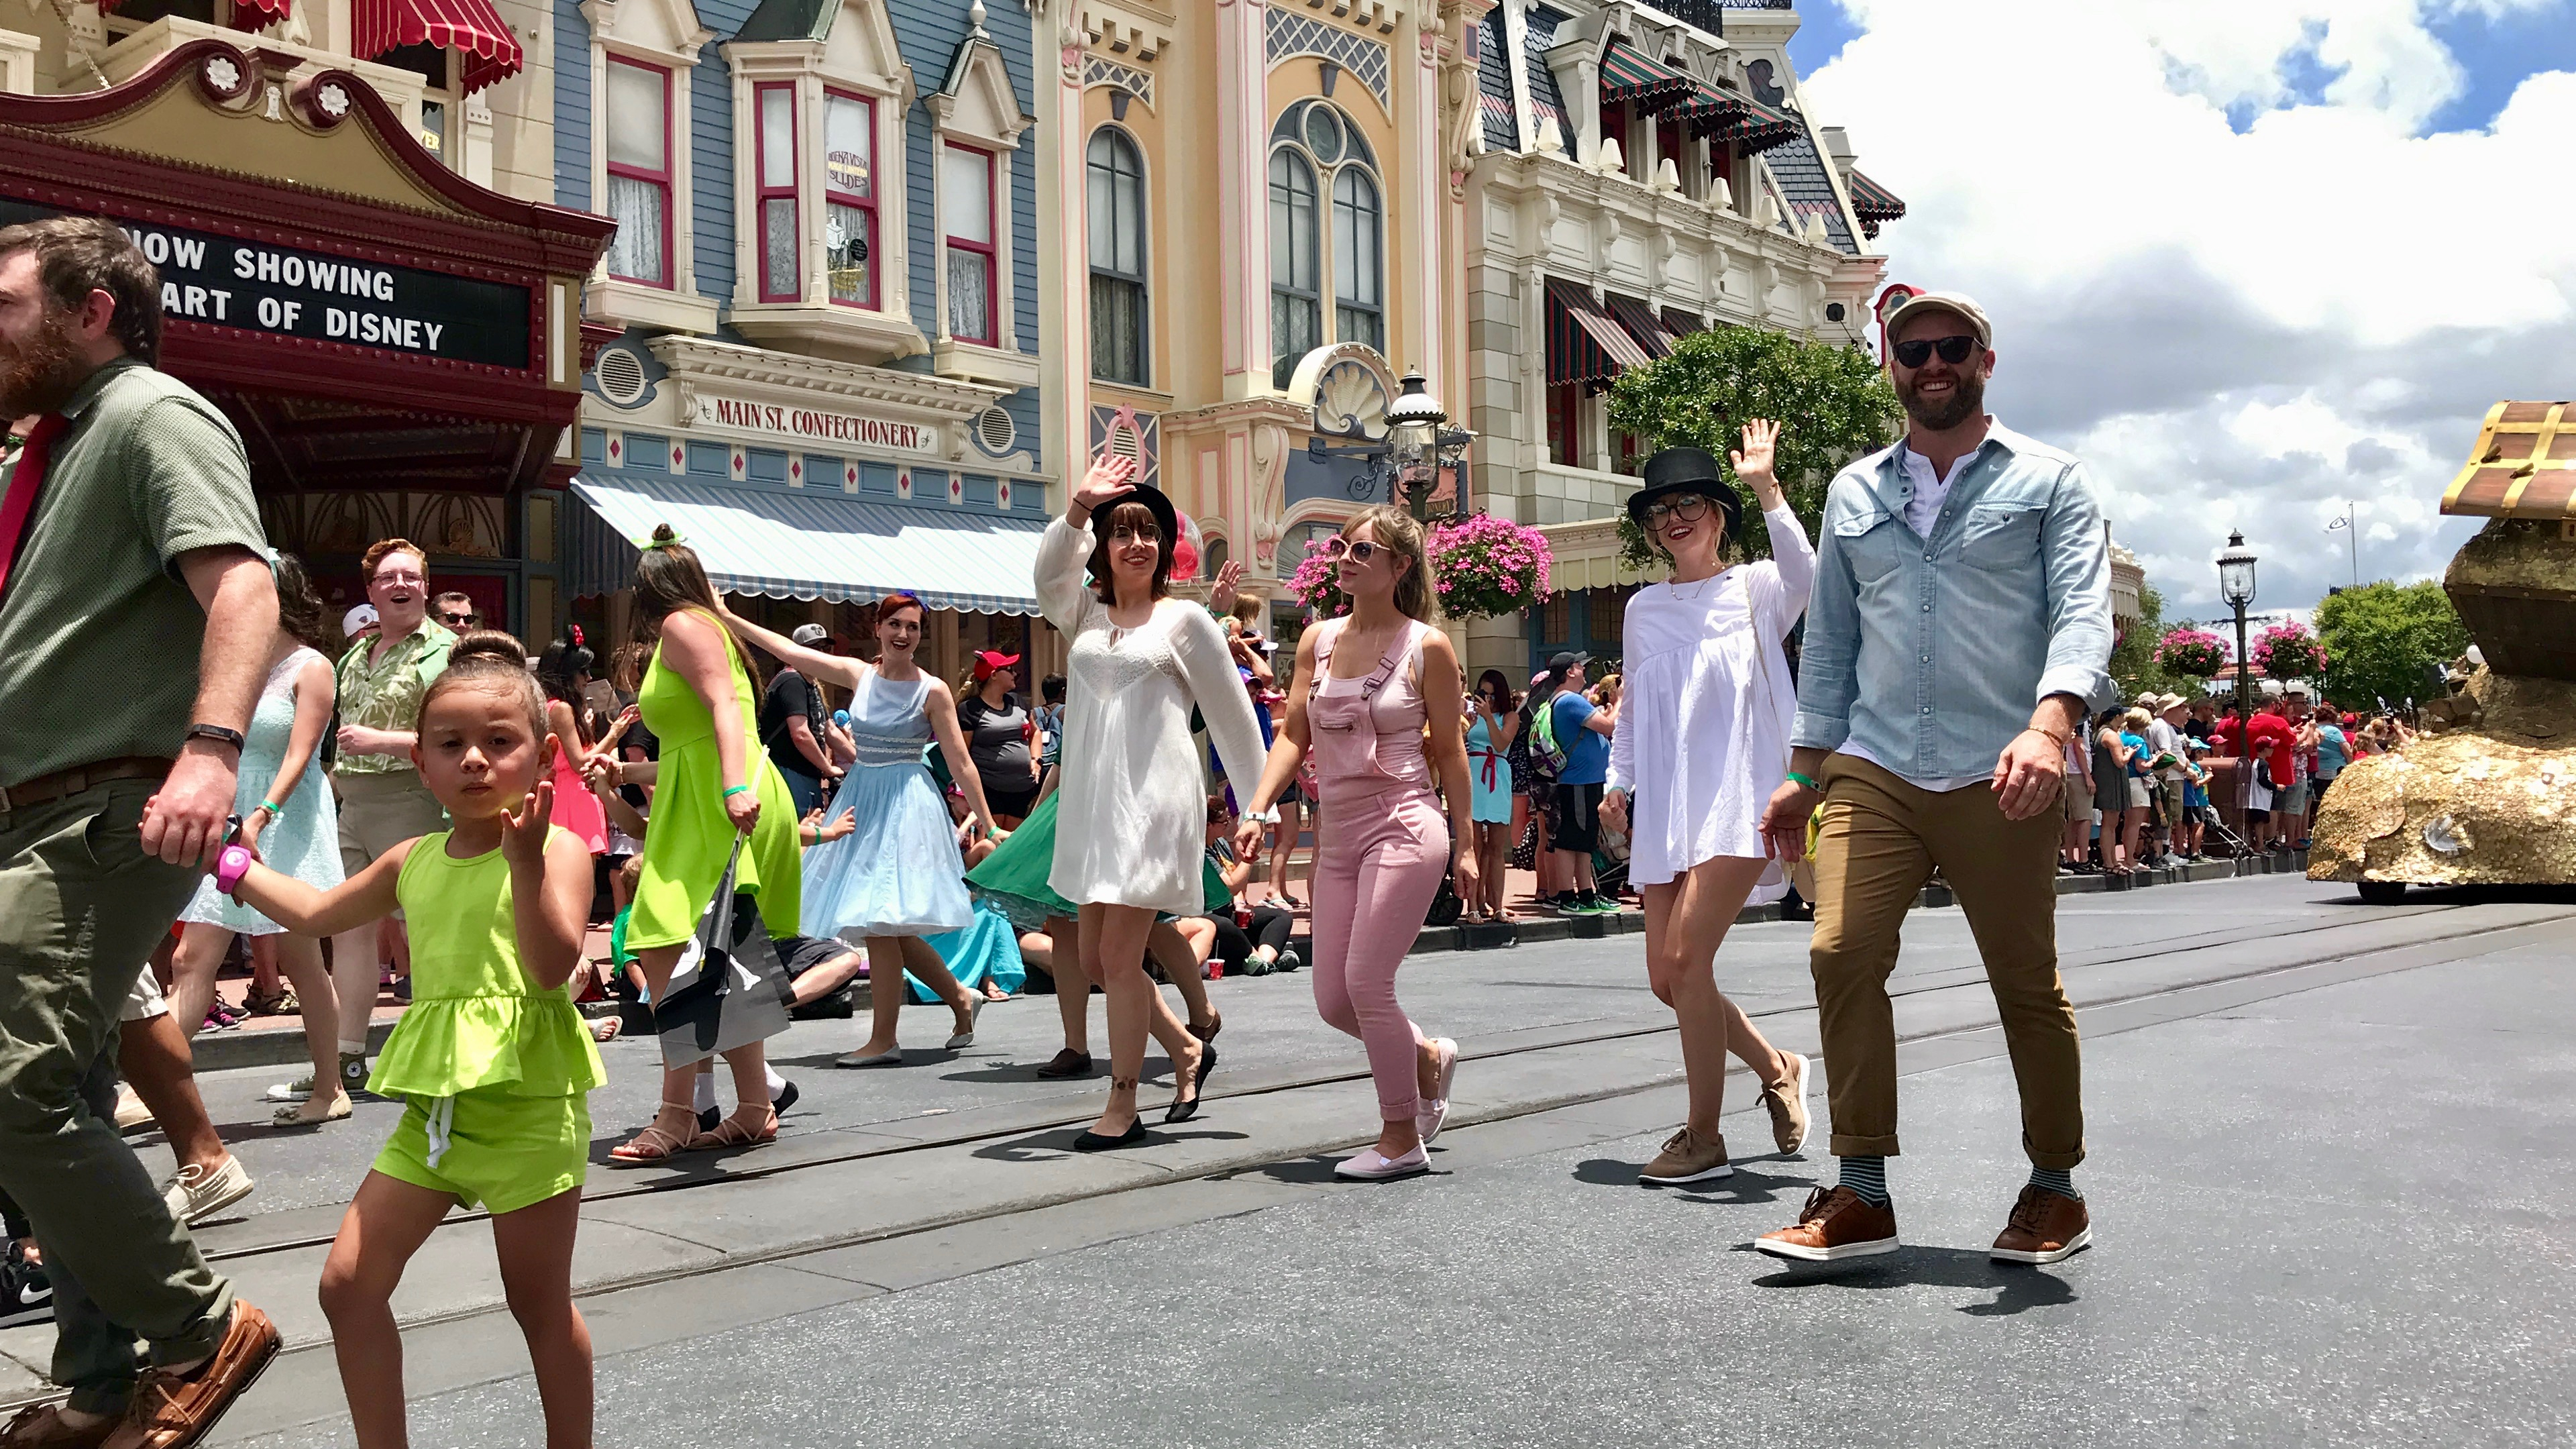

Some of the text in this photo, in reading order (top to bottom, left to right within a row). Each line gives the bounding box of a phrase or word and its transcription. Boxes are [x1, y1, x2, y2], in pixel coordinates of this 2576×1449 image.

[828, 151, 867, 169] BUENA VISTA
[829, 170, 867, 189] SLIDES
[233, 248, 394, 302] SHOWING
[161, 282, 443, 351] ART OF DISNEY
[716, 398, 920, 449] MAIN ST. CONFECTIONERY
